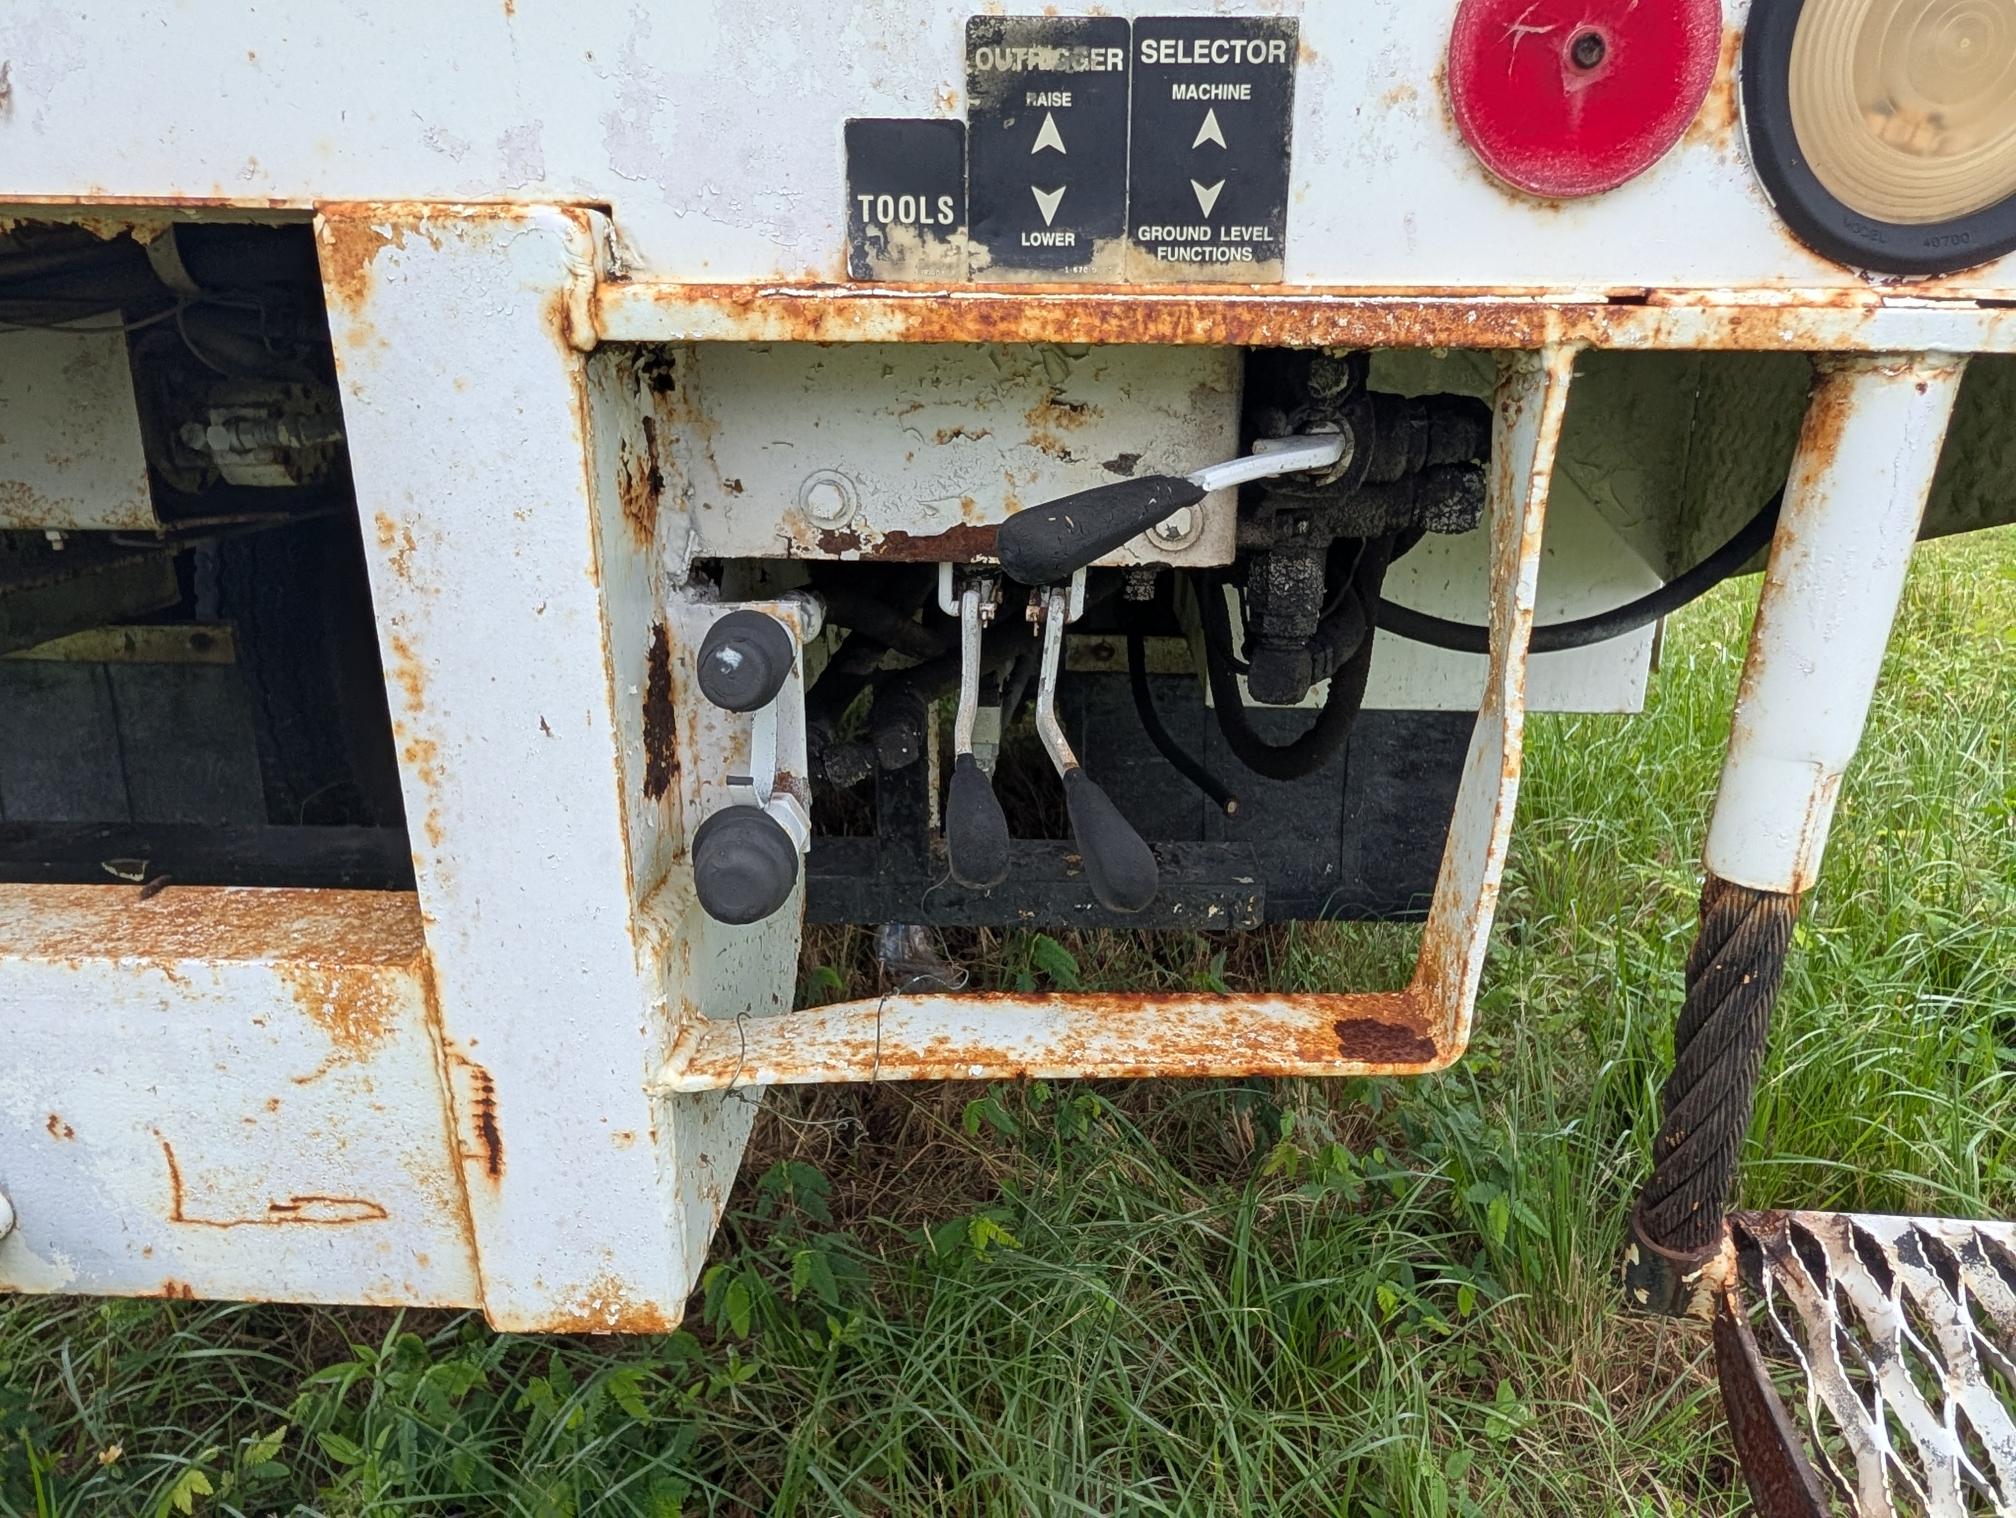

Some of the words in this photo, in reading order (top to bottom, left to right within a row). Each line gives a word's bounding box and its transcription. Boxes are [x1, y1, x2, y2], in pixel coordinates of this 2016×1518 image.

[1140, 39, 1287, 65] SELECTOR
[1026, 91, 1072, 108] RAISE
[1171, 83, 1251, 101] MACHINE
[857, 194, 955, 225] TOOLS
[1021, 231, 1075, 247] LOWER
[1138, 226, 1211, 242] GROUND
[1220, 226, 1274, 242] LEVEL
[1922, 232, 1970, 248] 40700
[1157, 246, 1253, 263] FUNCTIONS
